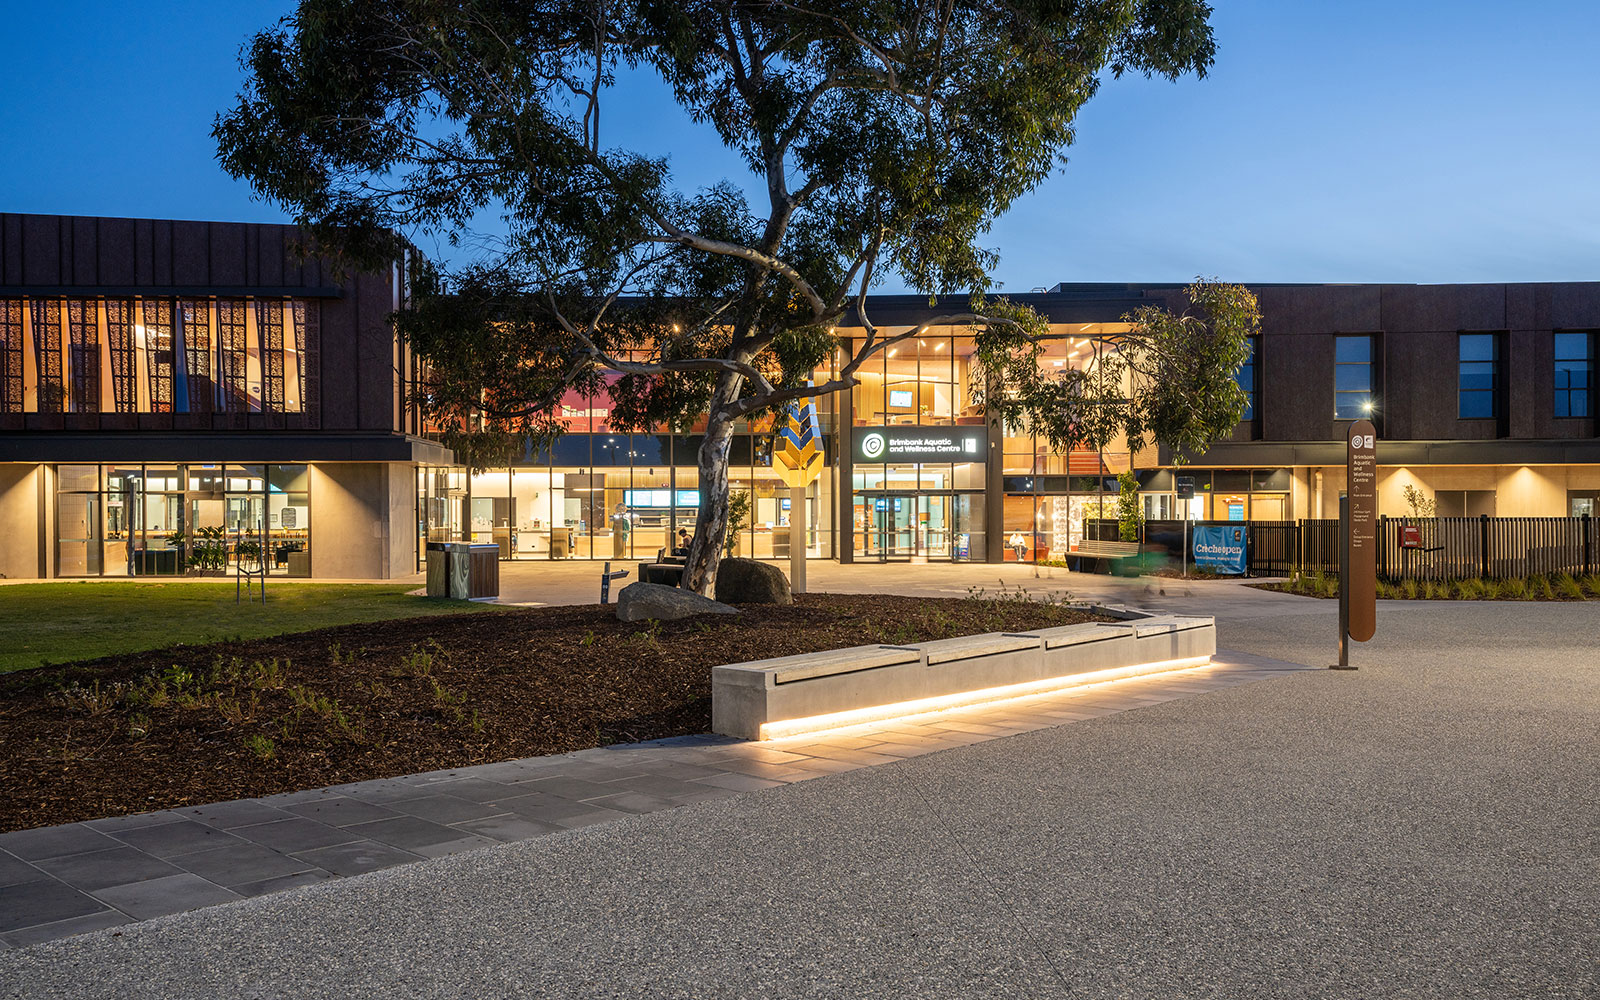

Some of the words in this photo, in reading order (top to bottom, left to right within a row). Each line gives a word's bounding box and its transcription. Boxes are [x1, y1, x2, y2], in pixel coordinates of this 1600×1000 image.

[889, 438, 923, 446] Brimbank
[924, 438, 951, 447] Aquatic
[905, 445, 936, 453] Wellness
